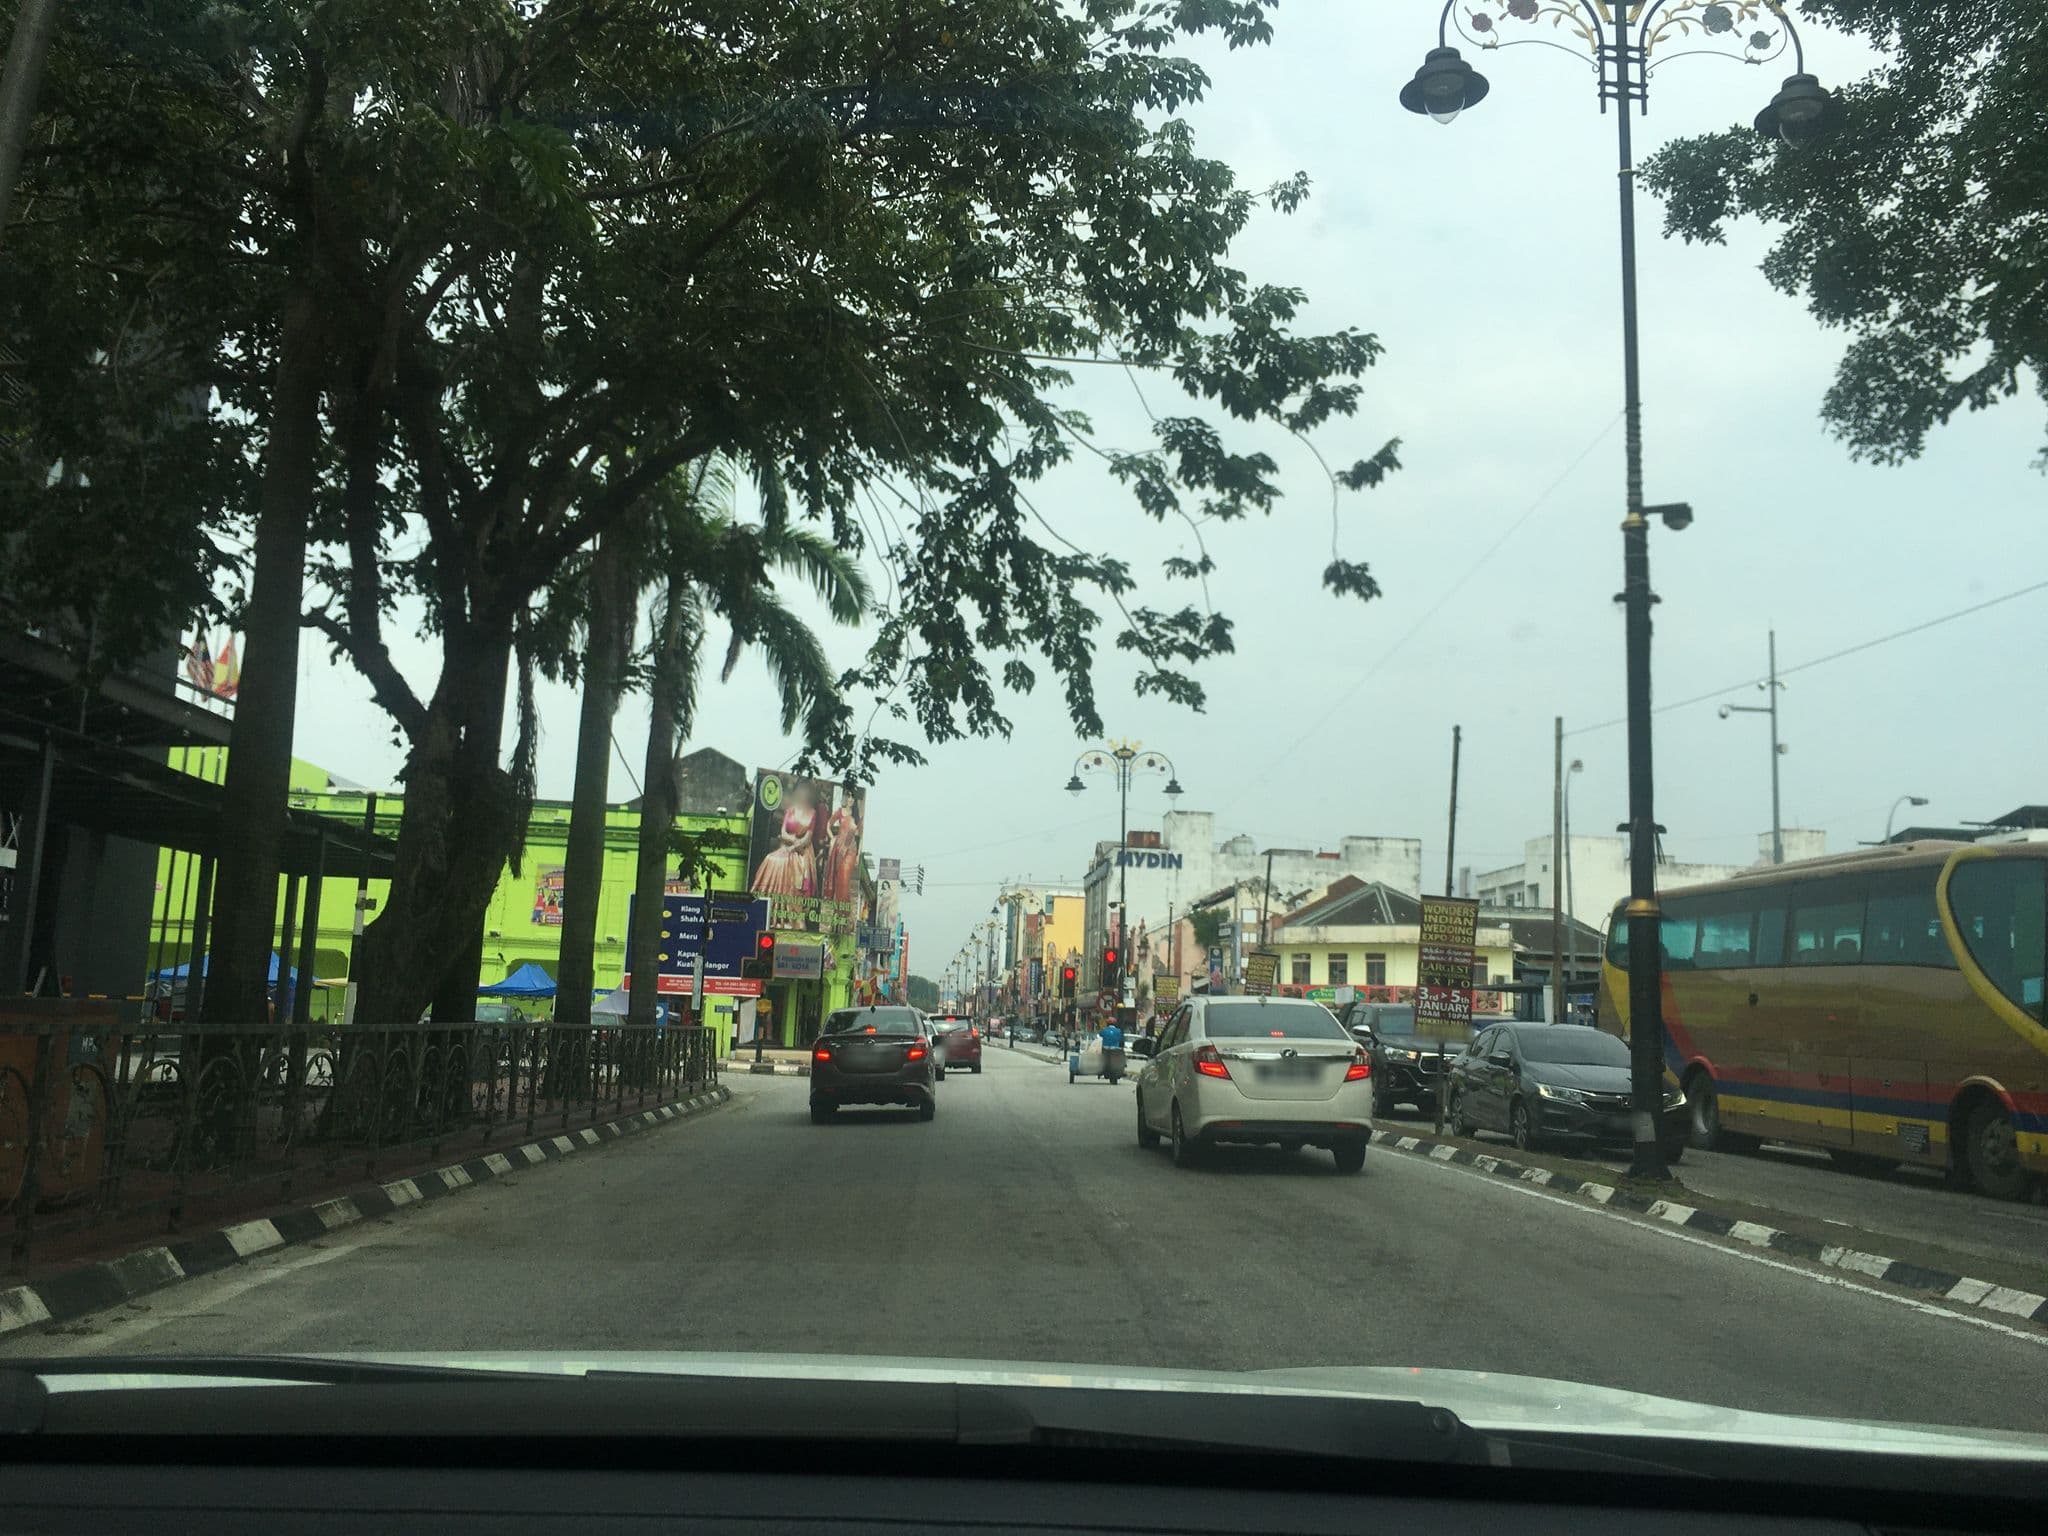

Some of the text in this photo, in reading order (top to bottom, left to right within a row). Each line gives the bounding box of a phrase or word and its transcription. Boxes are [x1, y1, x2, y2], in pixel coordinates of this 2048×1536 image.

[1115, 851, 1183, 869] MYDIN
[680, 905, 701, 915] Klang
[1423, 903, 1475, 918] WONDERS
[680, 915, 698, 923] Shah
[1423, 914, 1474, 926] INDIAN
[1423, 923, 1474, 936] WEDDING
[679, 932, 698, 940] Meru
[1422, 932, 1473, 944] EXPO 2020
[677, 949, 699, 959] Kapar
[1420, 961, 1469, 974] LARGEST
[1418, 986, 1439, 1001] 3rd
[1450, 990, 1470, 1004] 5th
[1418, 1000, 1470, 1013] JANUARY
[1418, 1009, 1470, 1020] 10AM 10PM
